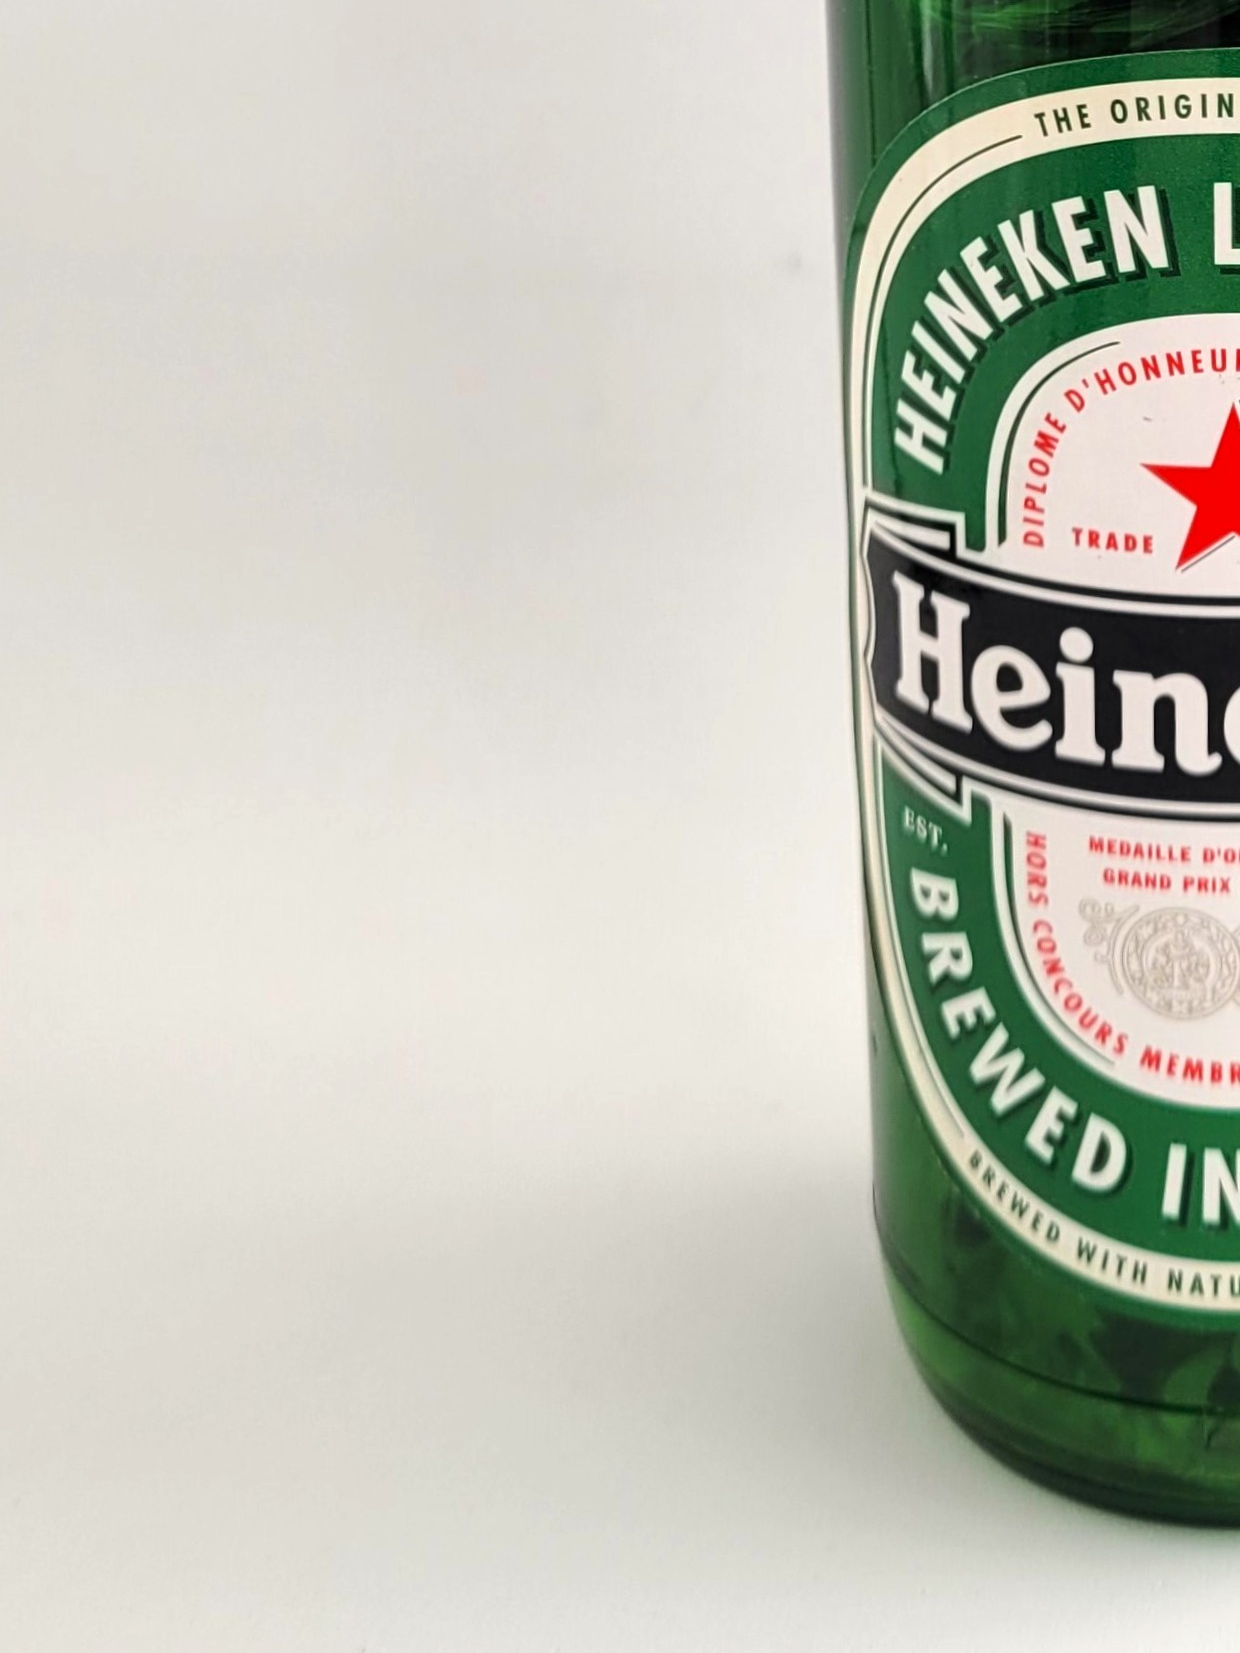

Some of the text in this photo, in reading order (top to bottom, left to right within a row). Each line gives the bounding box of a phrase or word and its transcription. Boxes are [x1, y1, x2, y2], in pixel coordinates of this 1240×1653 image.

[1034, 103, 1092, 137] THE
[894, 185, 1176, 475] HEINEKEN
[1022, 412, 1067, 548] DIPLOME
[1072, 527, 1154, 554] TRADE
[903, 805, 948, 854] EST.
[1089, 836, 1192, 862] MEDAILLE
[1025, 831, 1049, 906] HORS
[1103, 867, 1172, 891] GRAND
[1183, 875, 1231, 894] PRIX
[1033, 919, 1129, 1055] CONCOURS
[911, 867, 1131, 1194] BREWED
[970, 1150, 1061, 1243] BREWED
[1077, 1237, 1148, 1285] WITH
